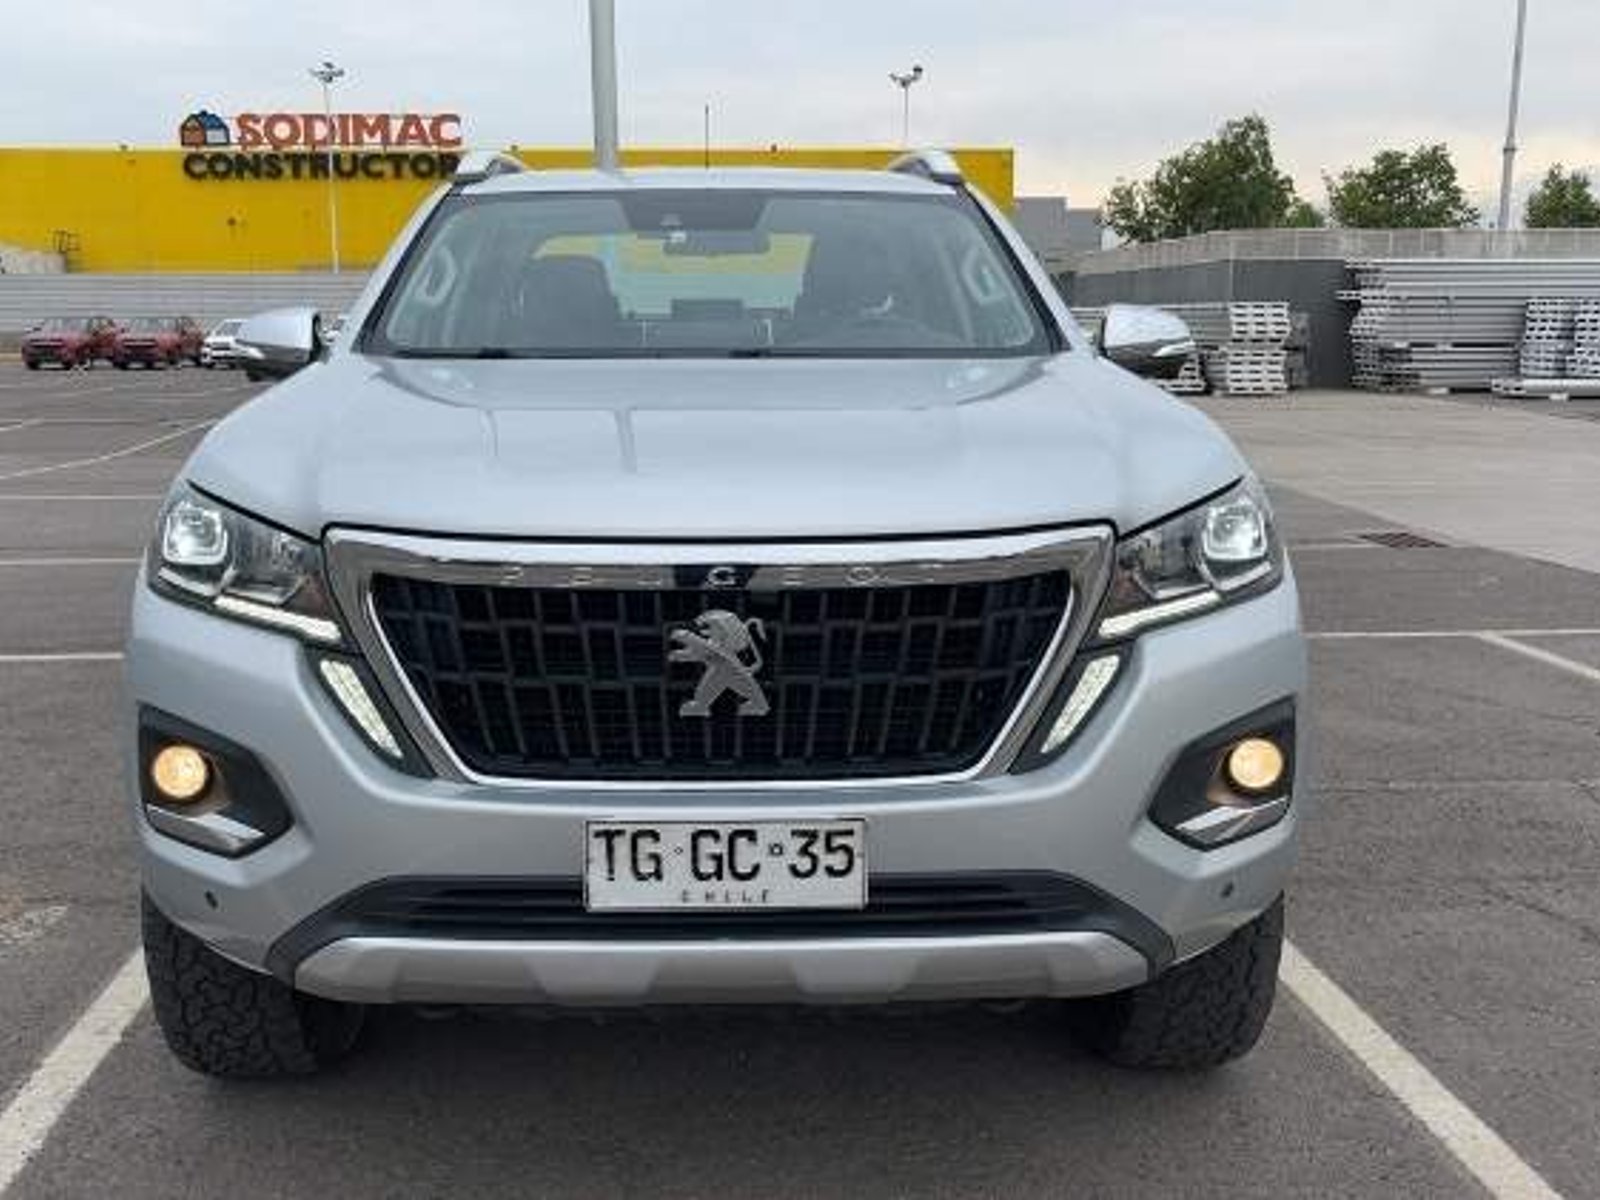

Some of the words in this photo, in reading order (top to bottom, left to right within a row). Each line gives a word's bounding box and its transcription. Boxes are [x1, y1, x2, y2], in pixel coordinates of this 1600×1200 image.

[235, 113, 463, 149] SODIMAC
[183, 152, 461, 181] CONSTRUCTOR
[593, 828, 663, 881] TG
[690, 828, 760, 882] GC
[788, 828, 856, 879] 35
